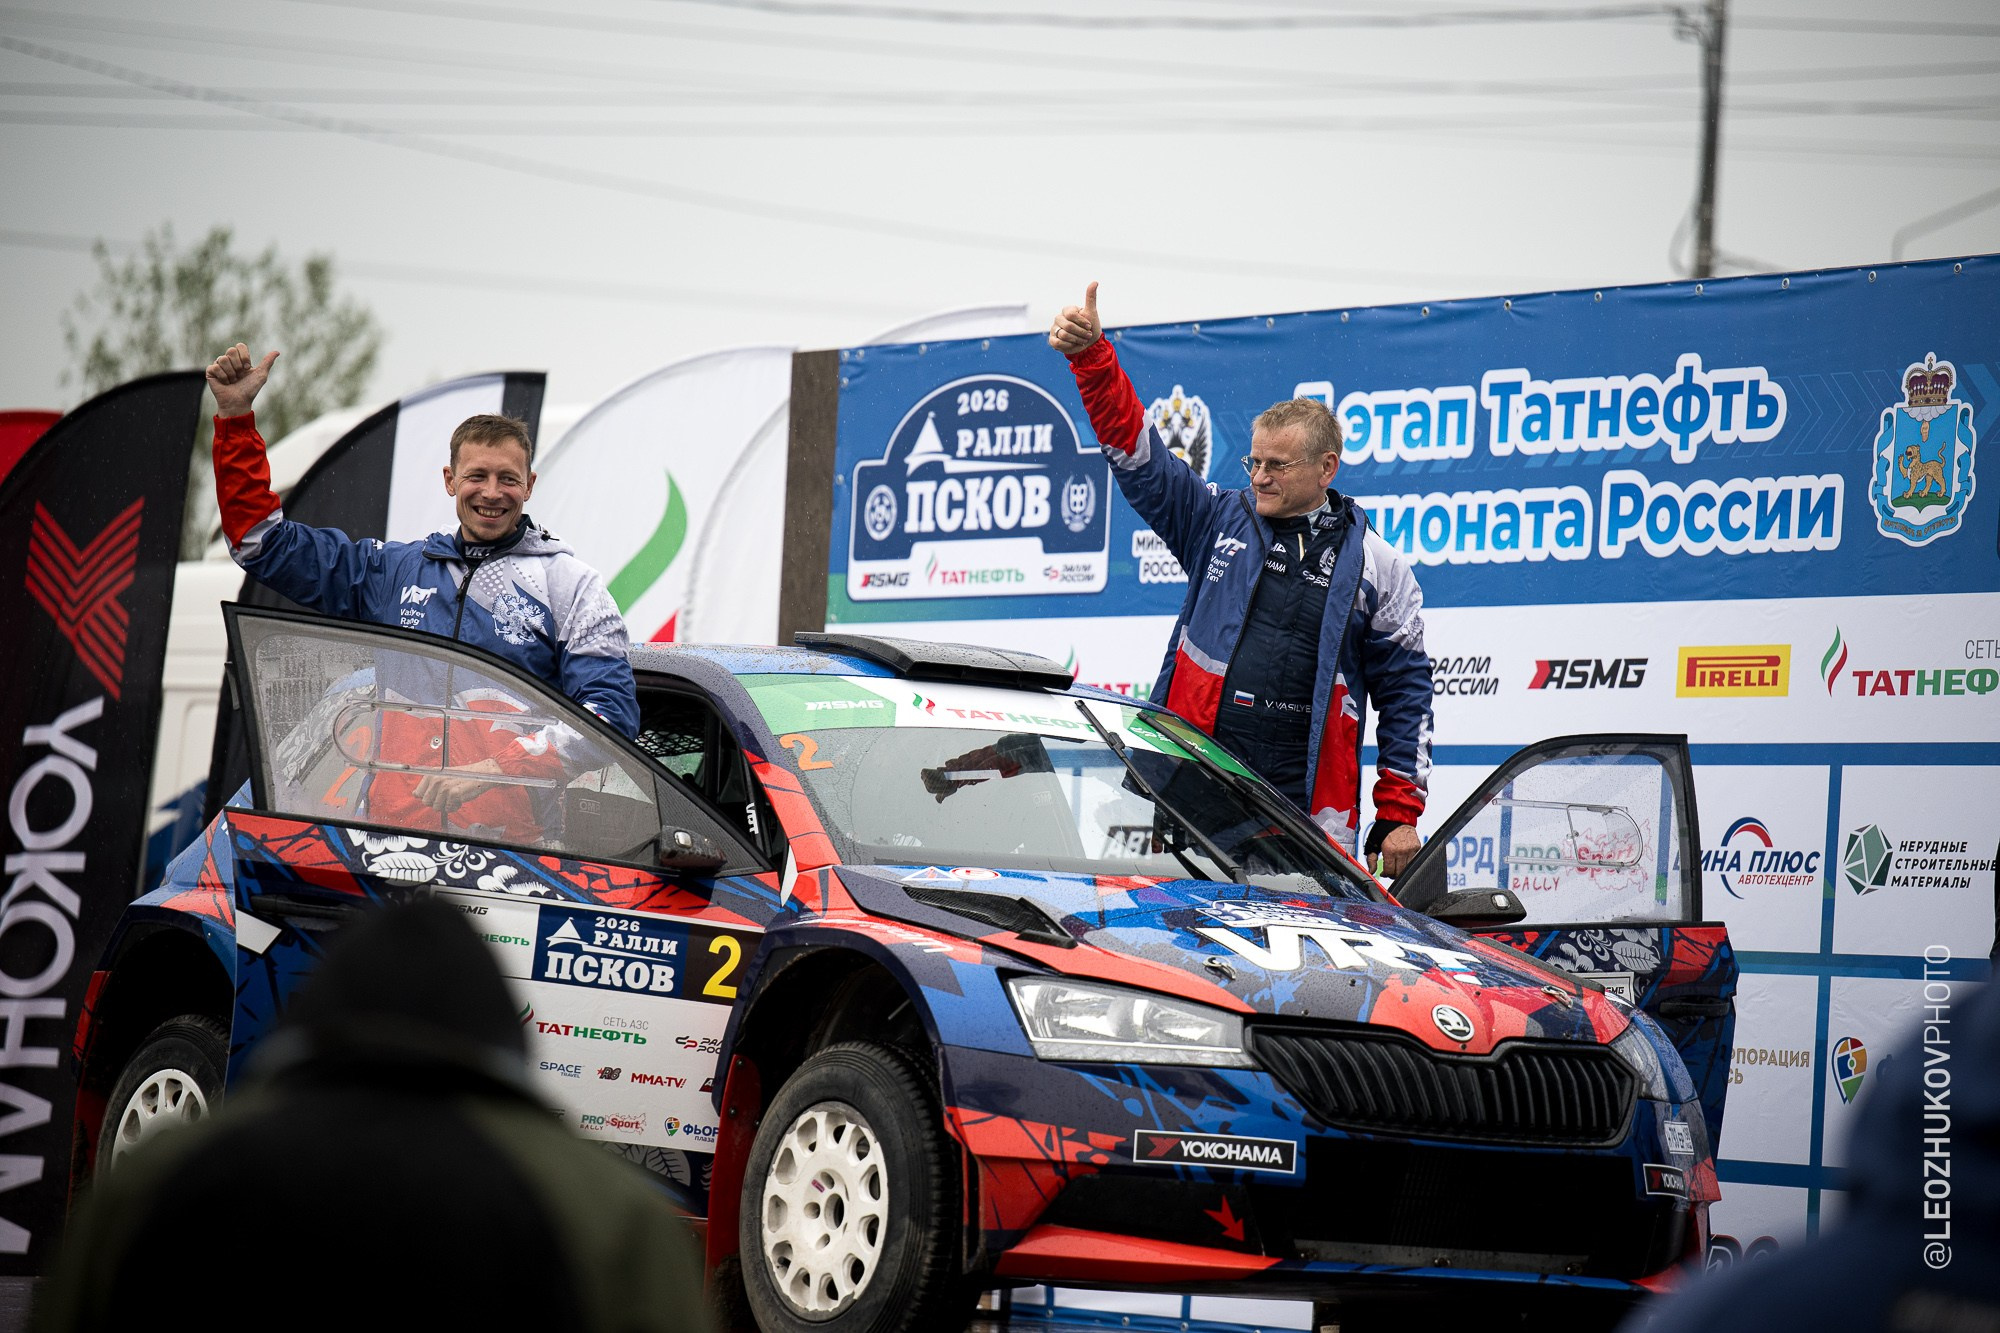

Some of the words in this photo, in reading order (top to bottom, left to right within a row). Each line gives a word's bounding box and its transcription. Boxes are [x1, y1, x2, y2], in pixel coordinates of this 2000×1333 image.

[957, 388, 1009, 416] 2026
[1343, 399, 1469, 452] этап
[1488, 365, 1780, 451] Татнефть
[956, 424, 1053, 458] РАЛЛИ
[904, 475, 1051, 533] ПСКОВ
[1605, 482, 1837, 546] России
[940, 567, 1025, 584] ТАТНЕФТЬ
[1528, 658, 1649, 690] ASMG
[1685, 655, 1781, 688] PIRELLI
[1852, 668, 2000, 697] ТАТНЕФ
[805, 700, 885, 711] ASMG
[780, 733, 834, 771] 2
[1515, 844, 1561, 875] PRO
[1899, 840, 1968, 855] НЕРУДНЫЕ
[1748, 850, 1821, 873] ПЛЮС
[1895, 858, 1997, 872] СТРОИТЕЛЬНЫЕ
[1512, 876, 1560, 891] RALLY
[1737, 873, 1815, 887] АВТОТЕХЦЕНТР
[1891, 876, 1972, 889] МАТЕРИАЛЫ
[594, 916, 641, 932] 2026
[593, 930, 678, 956] РАЛЛИ
[1194, 924, 1483, 986] VRT
[544, 951, 675, 992] ПСКОВ
[702, 935, 742, 999] 2
[536, 1021, 648, 1045] ТАТНЕФТЬ
[603, 1016, 627, 1028] СЕТЬ
[629, 1019, 649, 1030] АЗС
[539, 1061, 582, 1074] SPACE
[581, 1114, 605, 1125] PRO
[610, 1117, 641, 1130] Sport
[1180, 1140, 1283, 1165] YOKOHAMA
